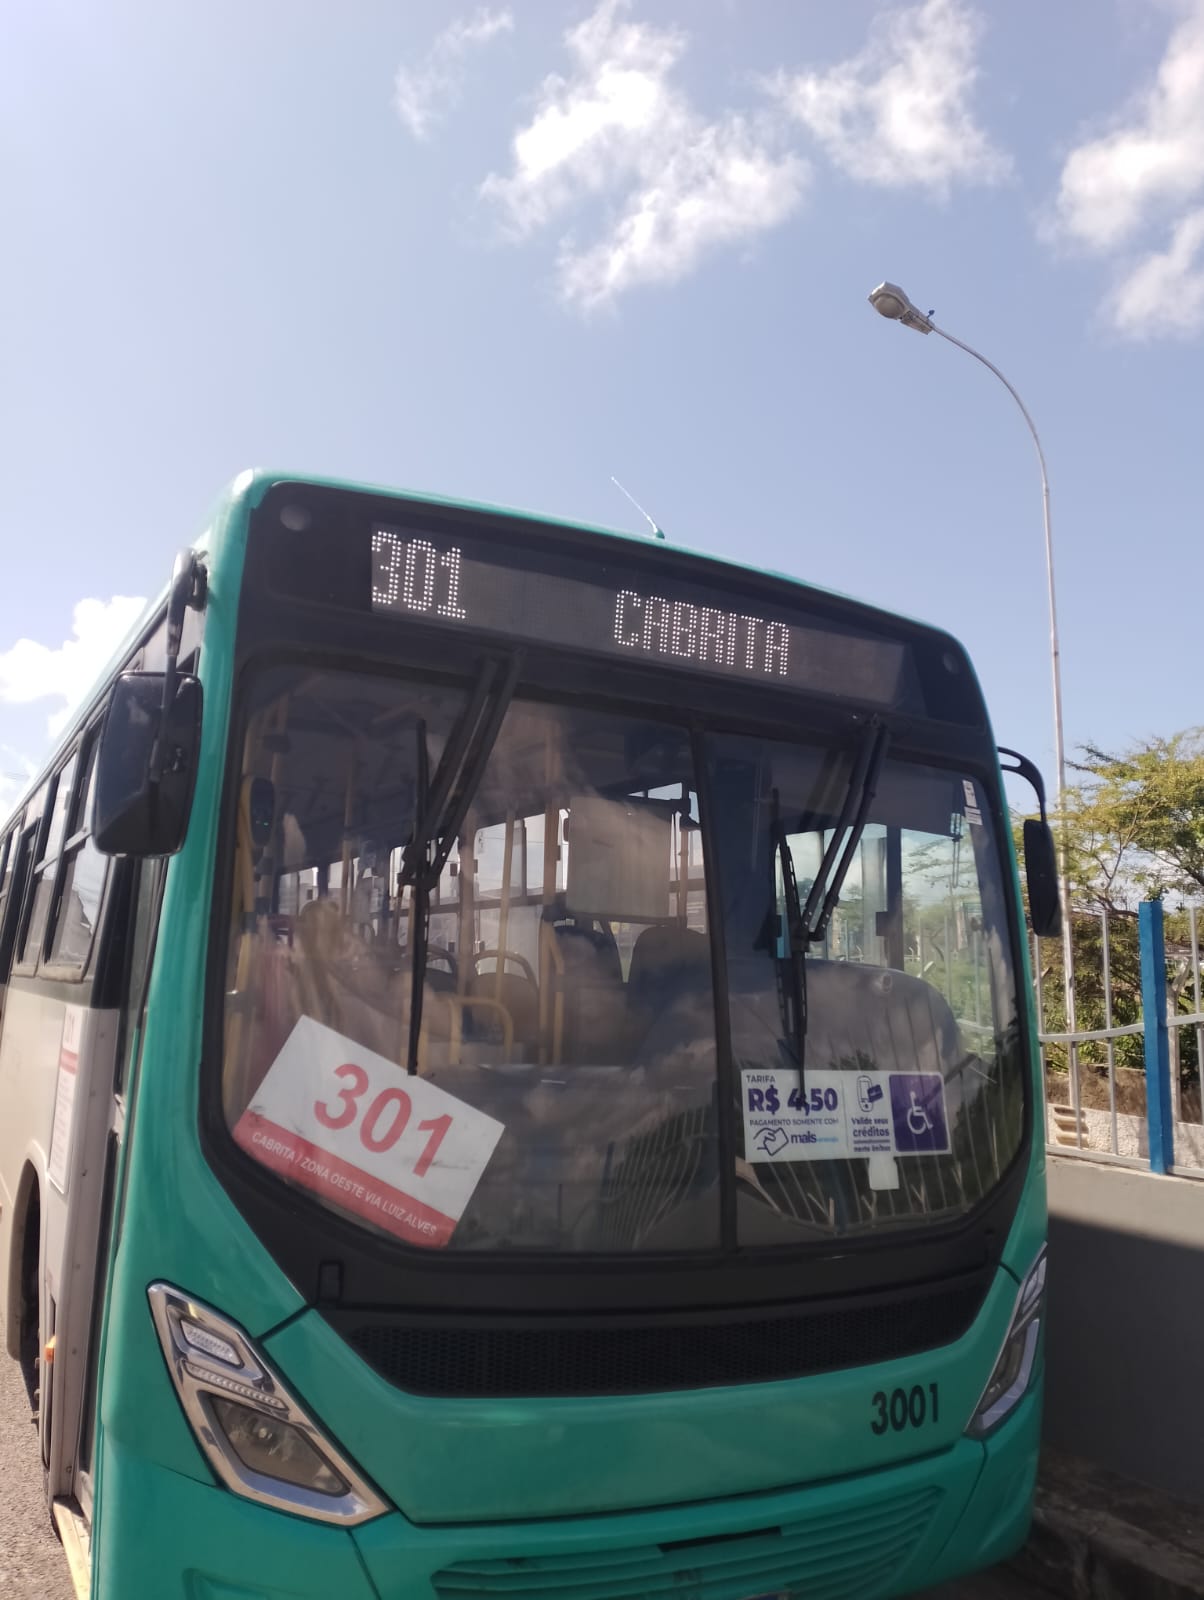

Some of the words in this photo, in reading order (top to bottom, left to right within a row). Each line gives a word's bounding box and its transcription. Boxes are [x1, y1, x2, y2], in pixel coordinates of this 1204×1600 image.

[371, 531, 466, 619] 301
[613, 589, 790, 675] CABRITA
[746, 1075, 776, 1083] TARIFA
[748, 1084, 781, 1116] R$
[787, 1087, 839, 1117] 4,50
[313, 1063, 454, 1178] 301
[749, 1118, 792, 1127] PAGAMENTO
[791, 1130, 817, 1144] mais
[852, 1126, 890, 1137] créditos
[252, 1132, 296, 1162] CABRITA
[301, 1155, 330, 1179] ZONA
[330, 1173, 365, 1199] OESTE
[365, 1191, 382, 1209] VIA
[382, 1200, 406, 1220] LUIZ
[404, 1213, 437, 1236] ALVES
[870, 1383, 939, 1436] 3001
